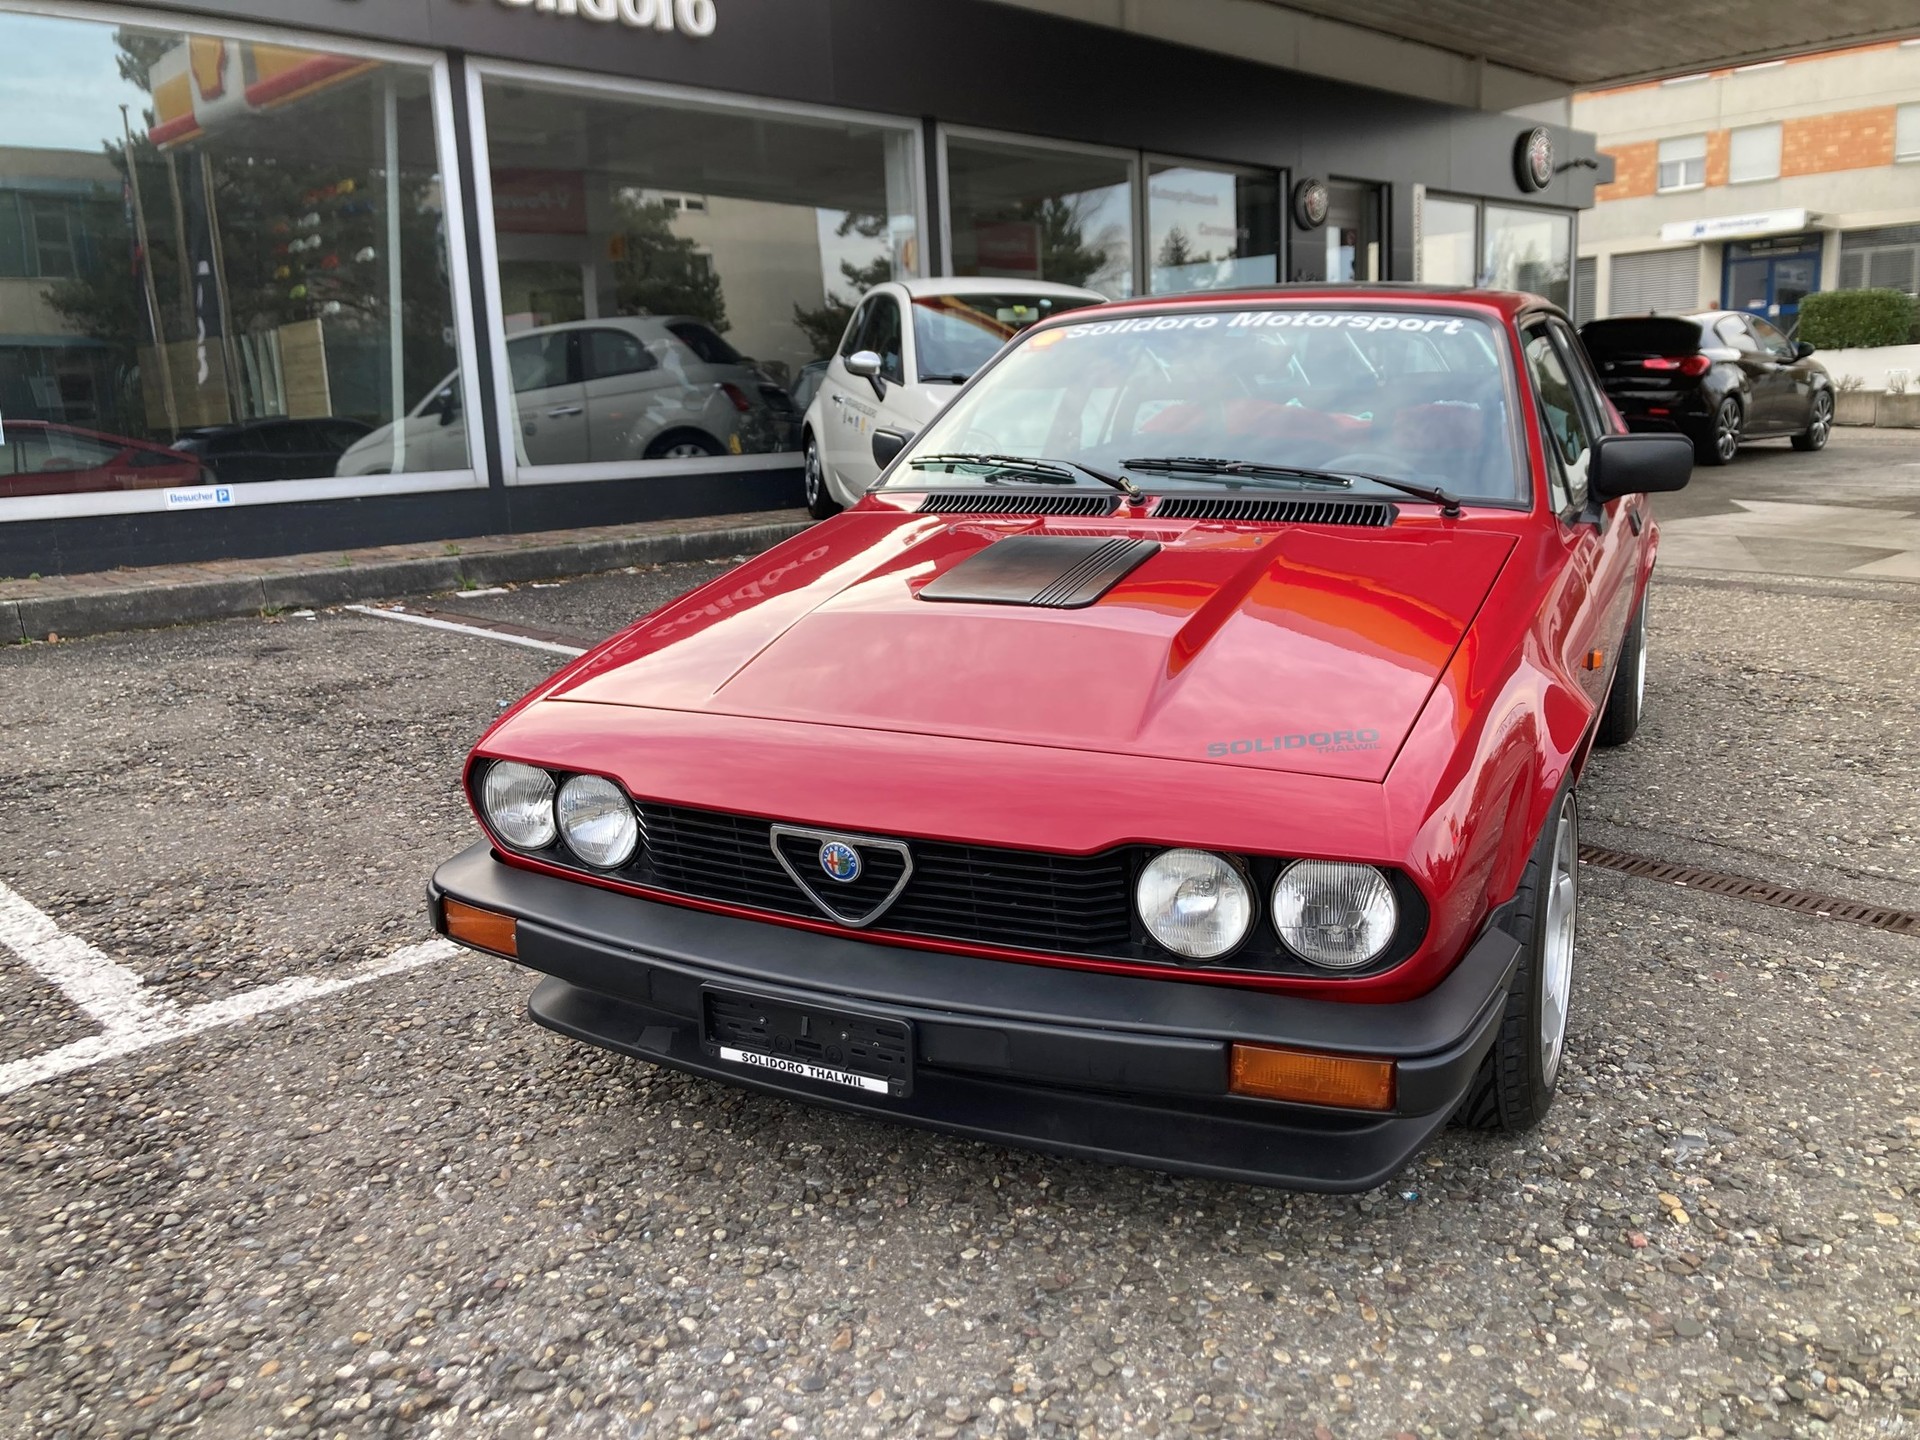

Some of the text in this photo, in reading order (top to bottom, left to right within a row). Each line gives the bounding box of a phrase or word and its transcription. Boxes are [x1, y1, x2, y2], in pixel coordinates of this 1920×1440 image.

[1066, 311, 1464, 339] Solidoro Motorsport
[170, 493, 213, 503] Besucher
[1206, 729, 1380, 758] SOLIDORO
[1317, 743, 1382, 754] THALWIL
[741, 1052, 866, 1088] SOLIDORO THALWIL
